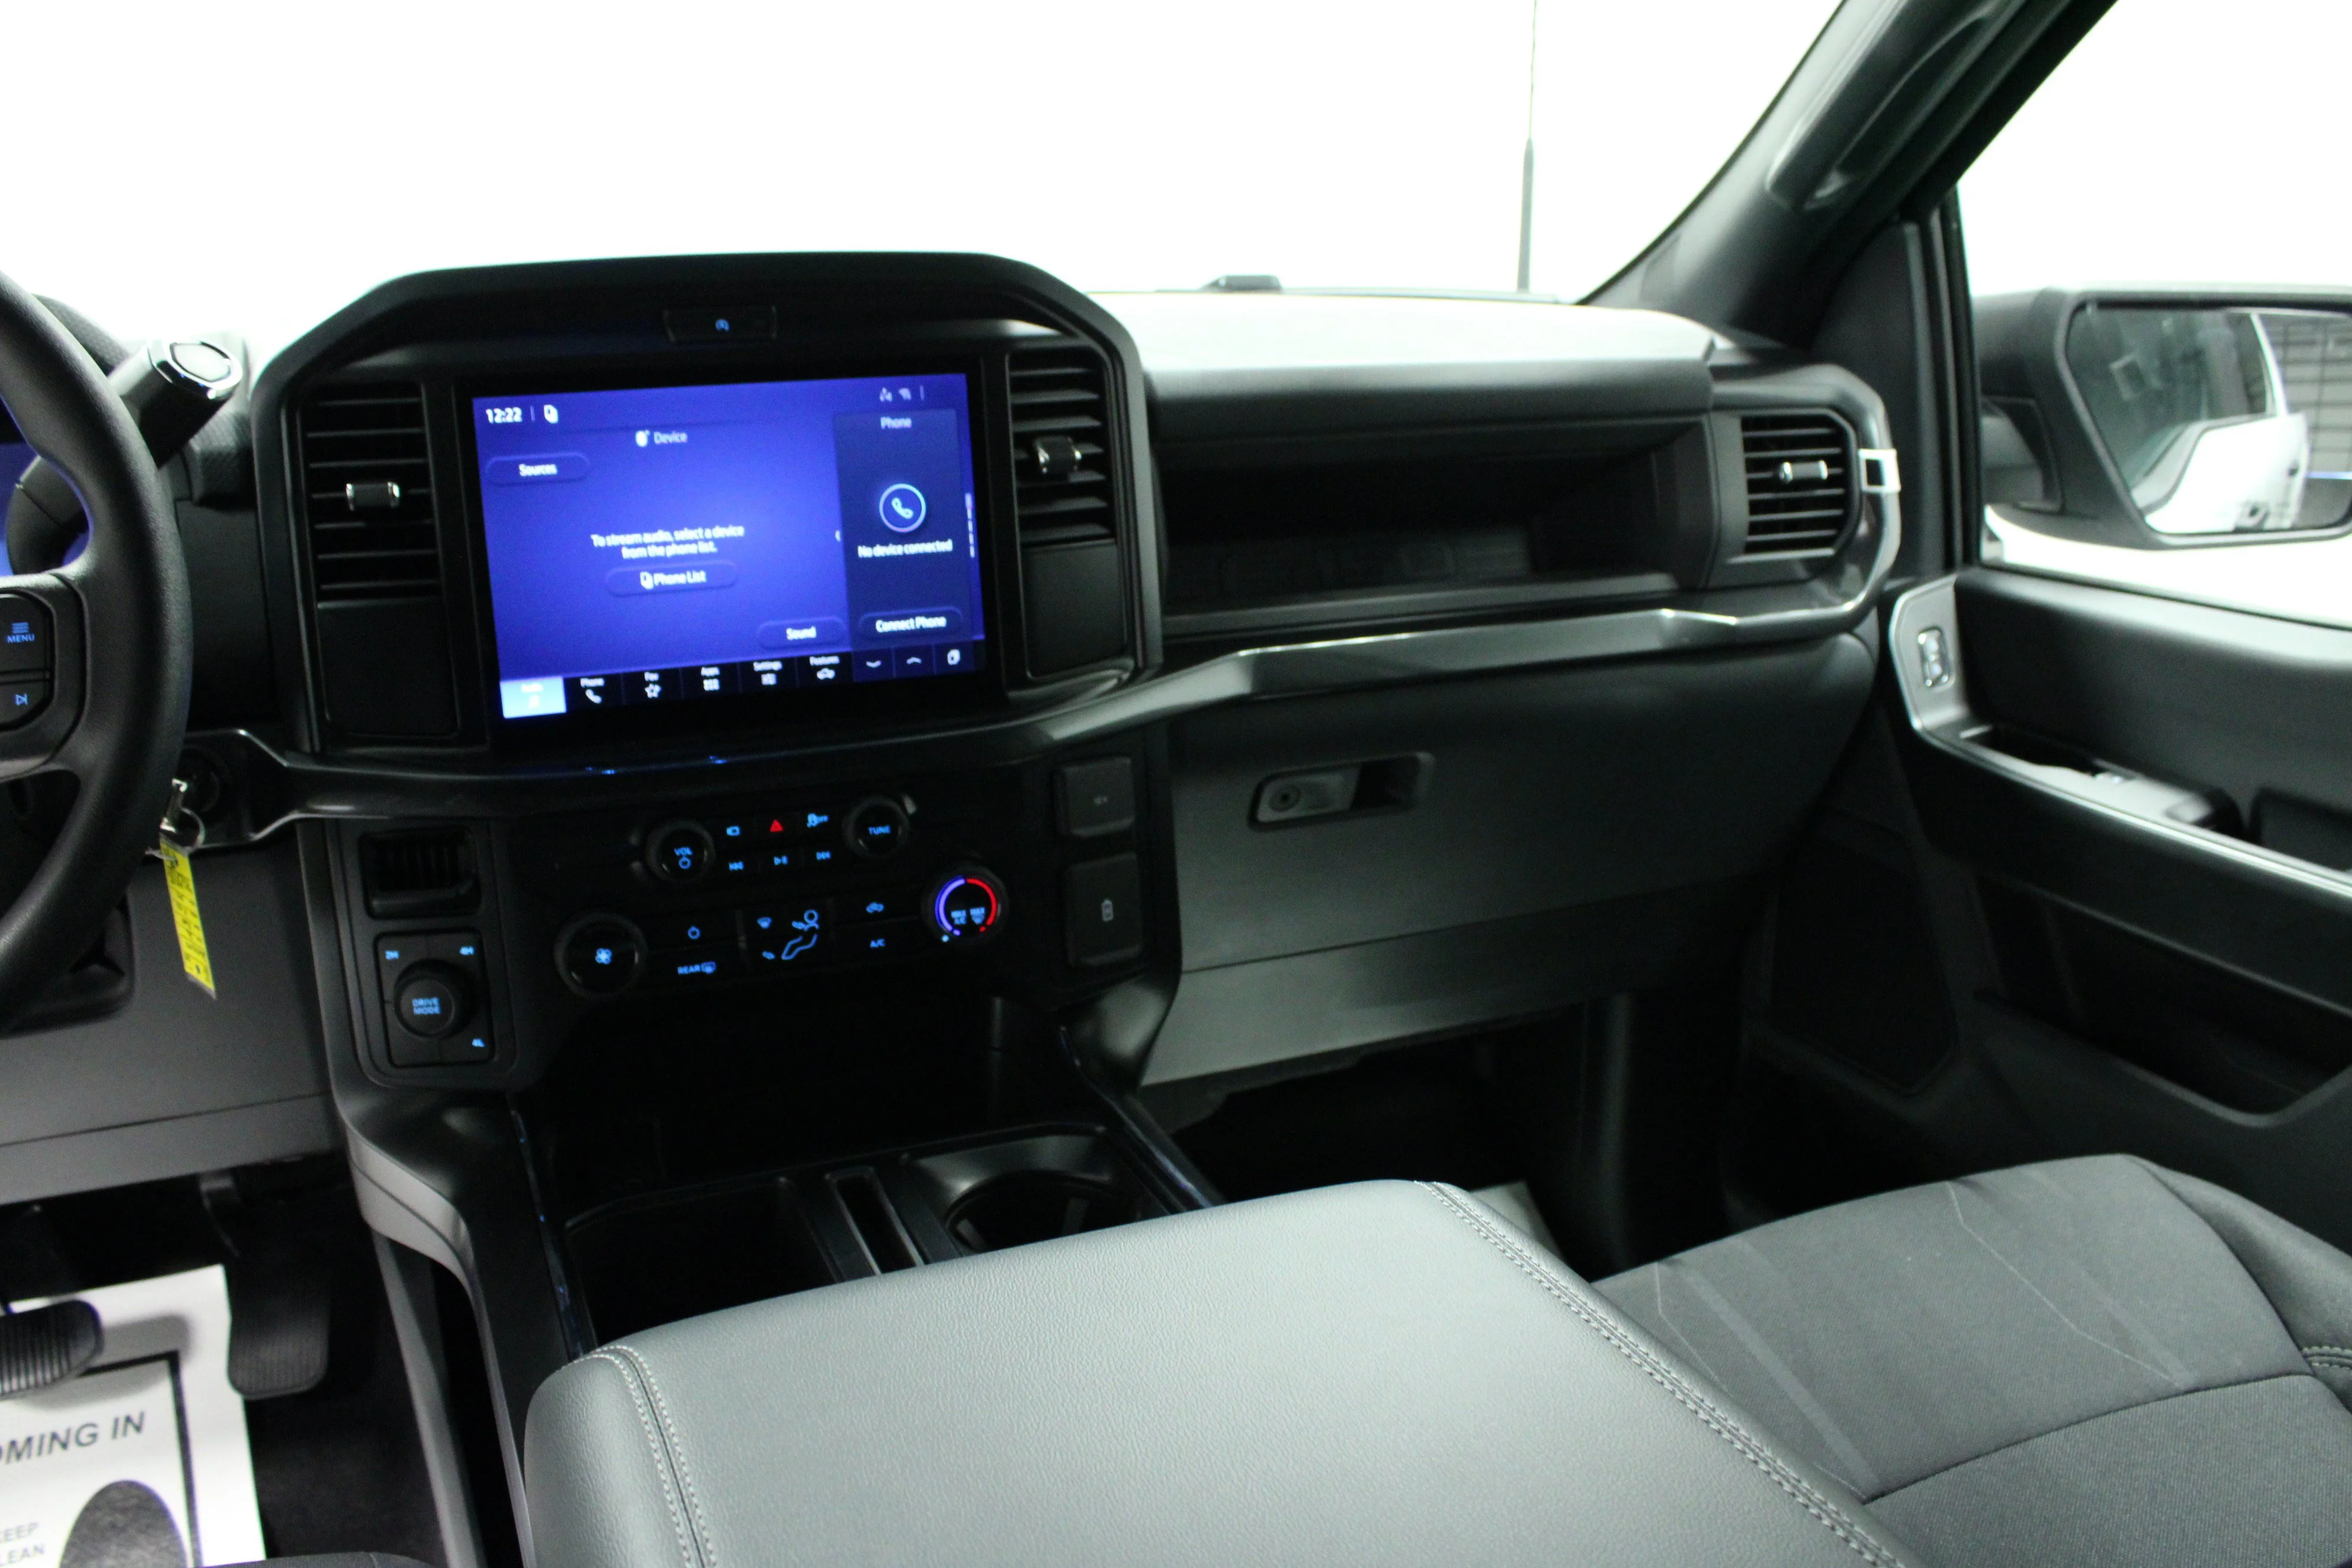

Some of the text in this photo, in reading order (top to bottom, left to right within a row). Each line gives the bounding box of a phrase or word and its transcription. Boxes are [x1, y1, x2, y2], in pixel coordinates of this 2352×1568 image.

[485, 407, 522, 423] 12:22
[654, 431, 688, 445] Device
[915, 616, 947, 629] Phone
[6, 633, 35, 643] MENU
[786, 626, 816, 641] Sound
[868, 825, 891, 835] TUNE
[674, 847, 692, 855] VOL
[677, 964, 701, 975] REAR
[0, 1410, 145, 1464] MING IN
